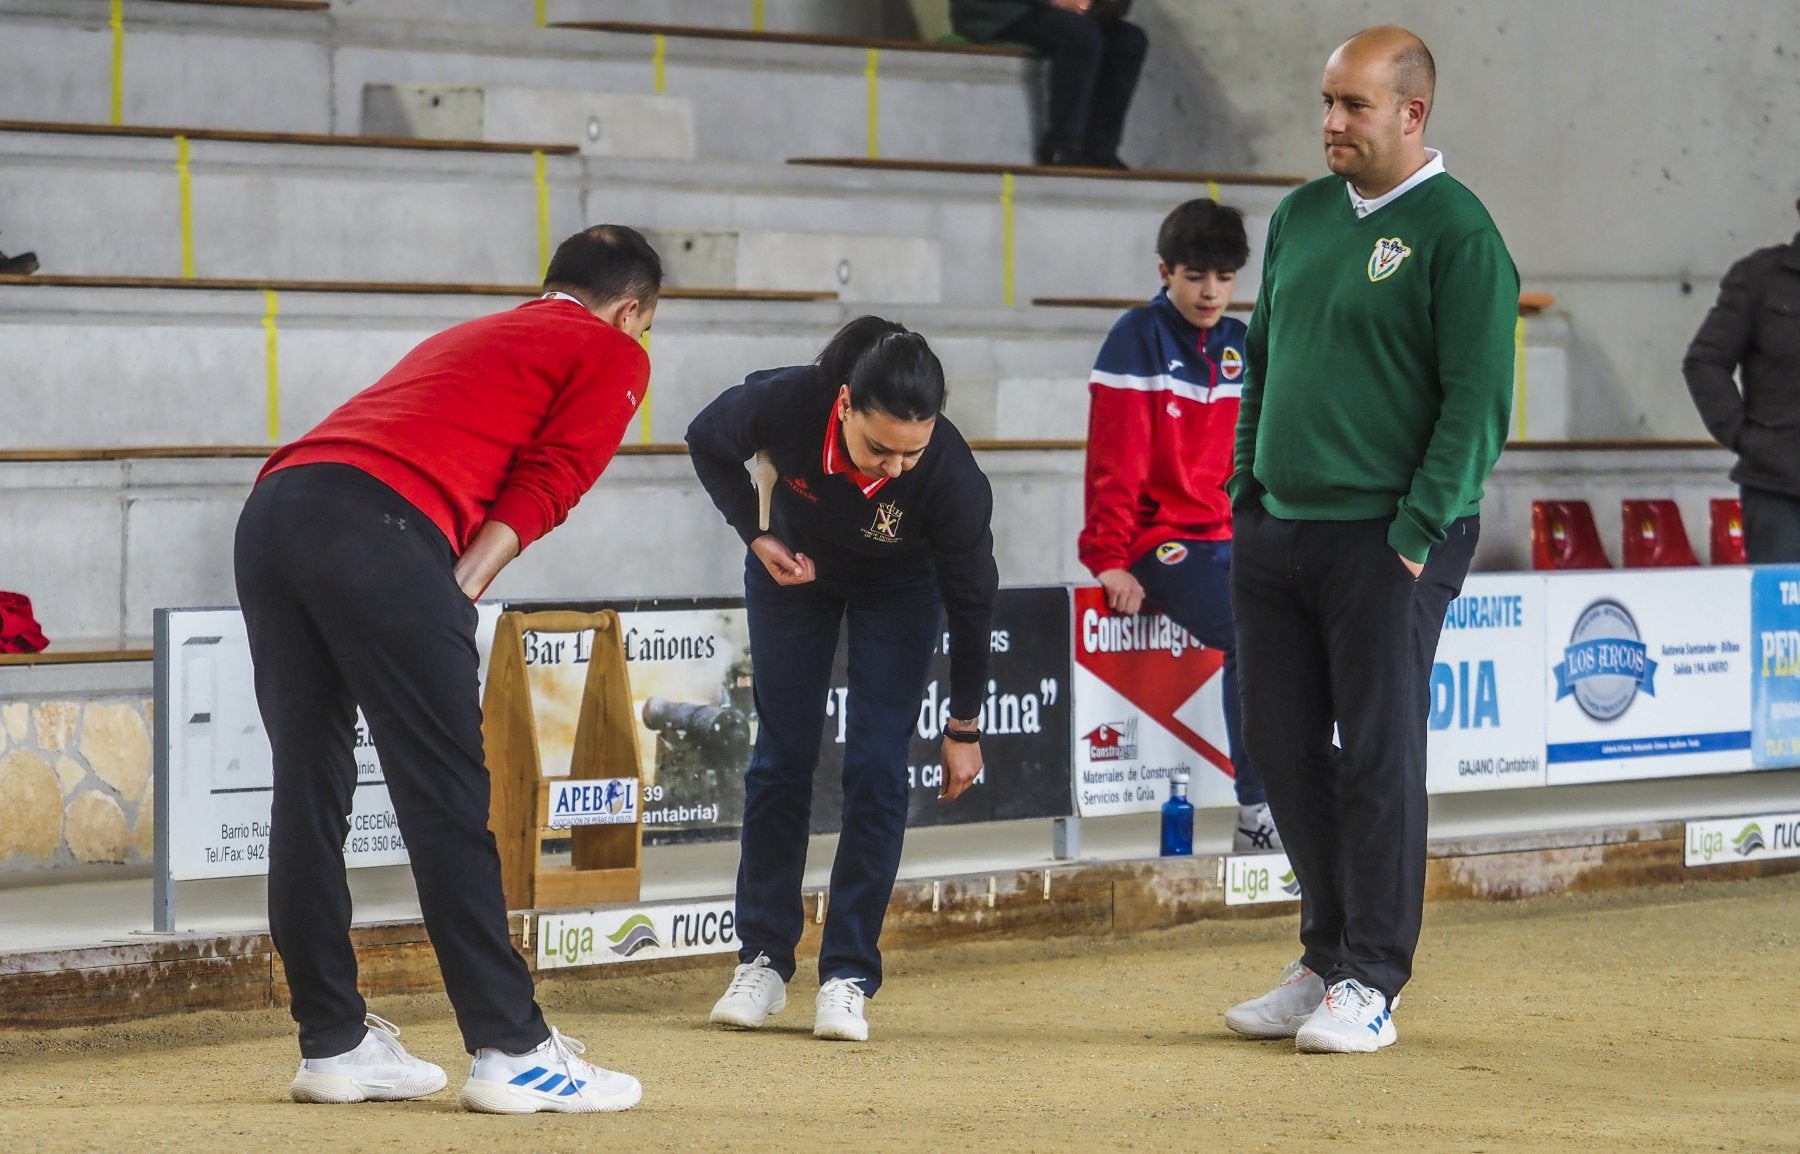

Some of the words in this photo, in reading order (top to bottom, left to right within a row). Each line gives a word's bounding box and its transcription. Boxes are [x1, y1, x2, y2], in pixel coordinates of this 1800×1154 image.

[1446, 594, 1522, 630] AURANTE
[523, 630, 565, 665] Bar
[624, 627, 715, 661] Cañones
[1568, 647, 1594, 674] LOS
[1598, 644, 1644, 672] ARCOS
[1084, 769, 1124, 784] Materiales
[1127, 767, 1137, 780] de
[1459, 760, 1494, 777] GAJANO
[1496, 756, 1539, 776] (Cantabria)
[1083, 789, 1120, 805] Servicios
[1122, 787, 1133, 802] de
[641, 804, 718, 823] antabria)
[221, 823, 249, 840] Barrio
[1690, 826, 1723, 861] Liga
[205, 846, 244, 864] Tel./Fax:
[246, 844, 264, 860] 942
[352, 837, 369, 853] 625
[371, 835, 388, 852] 350
[1231, 862, 1269, 900] Liga
[545, 920, 594, 963] Liga
